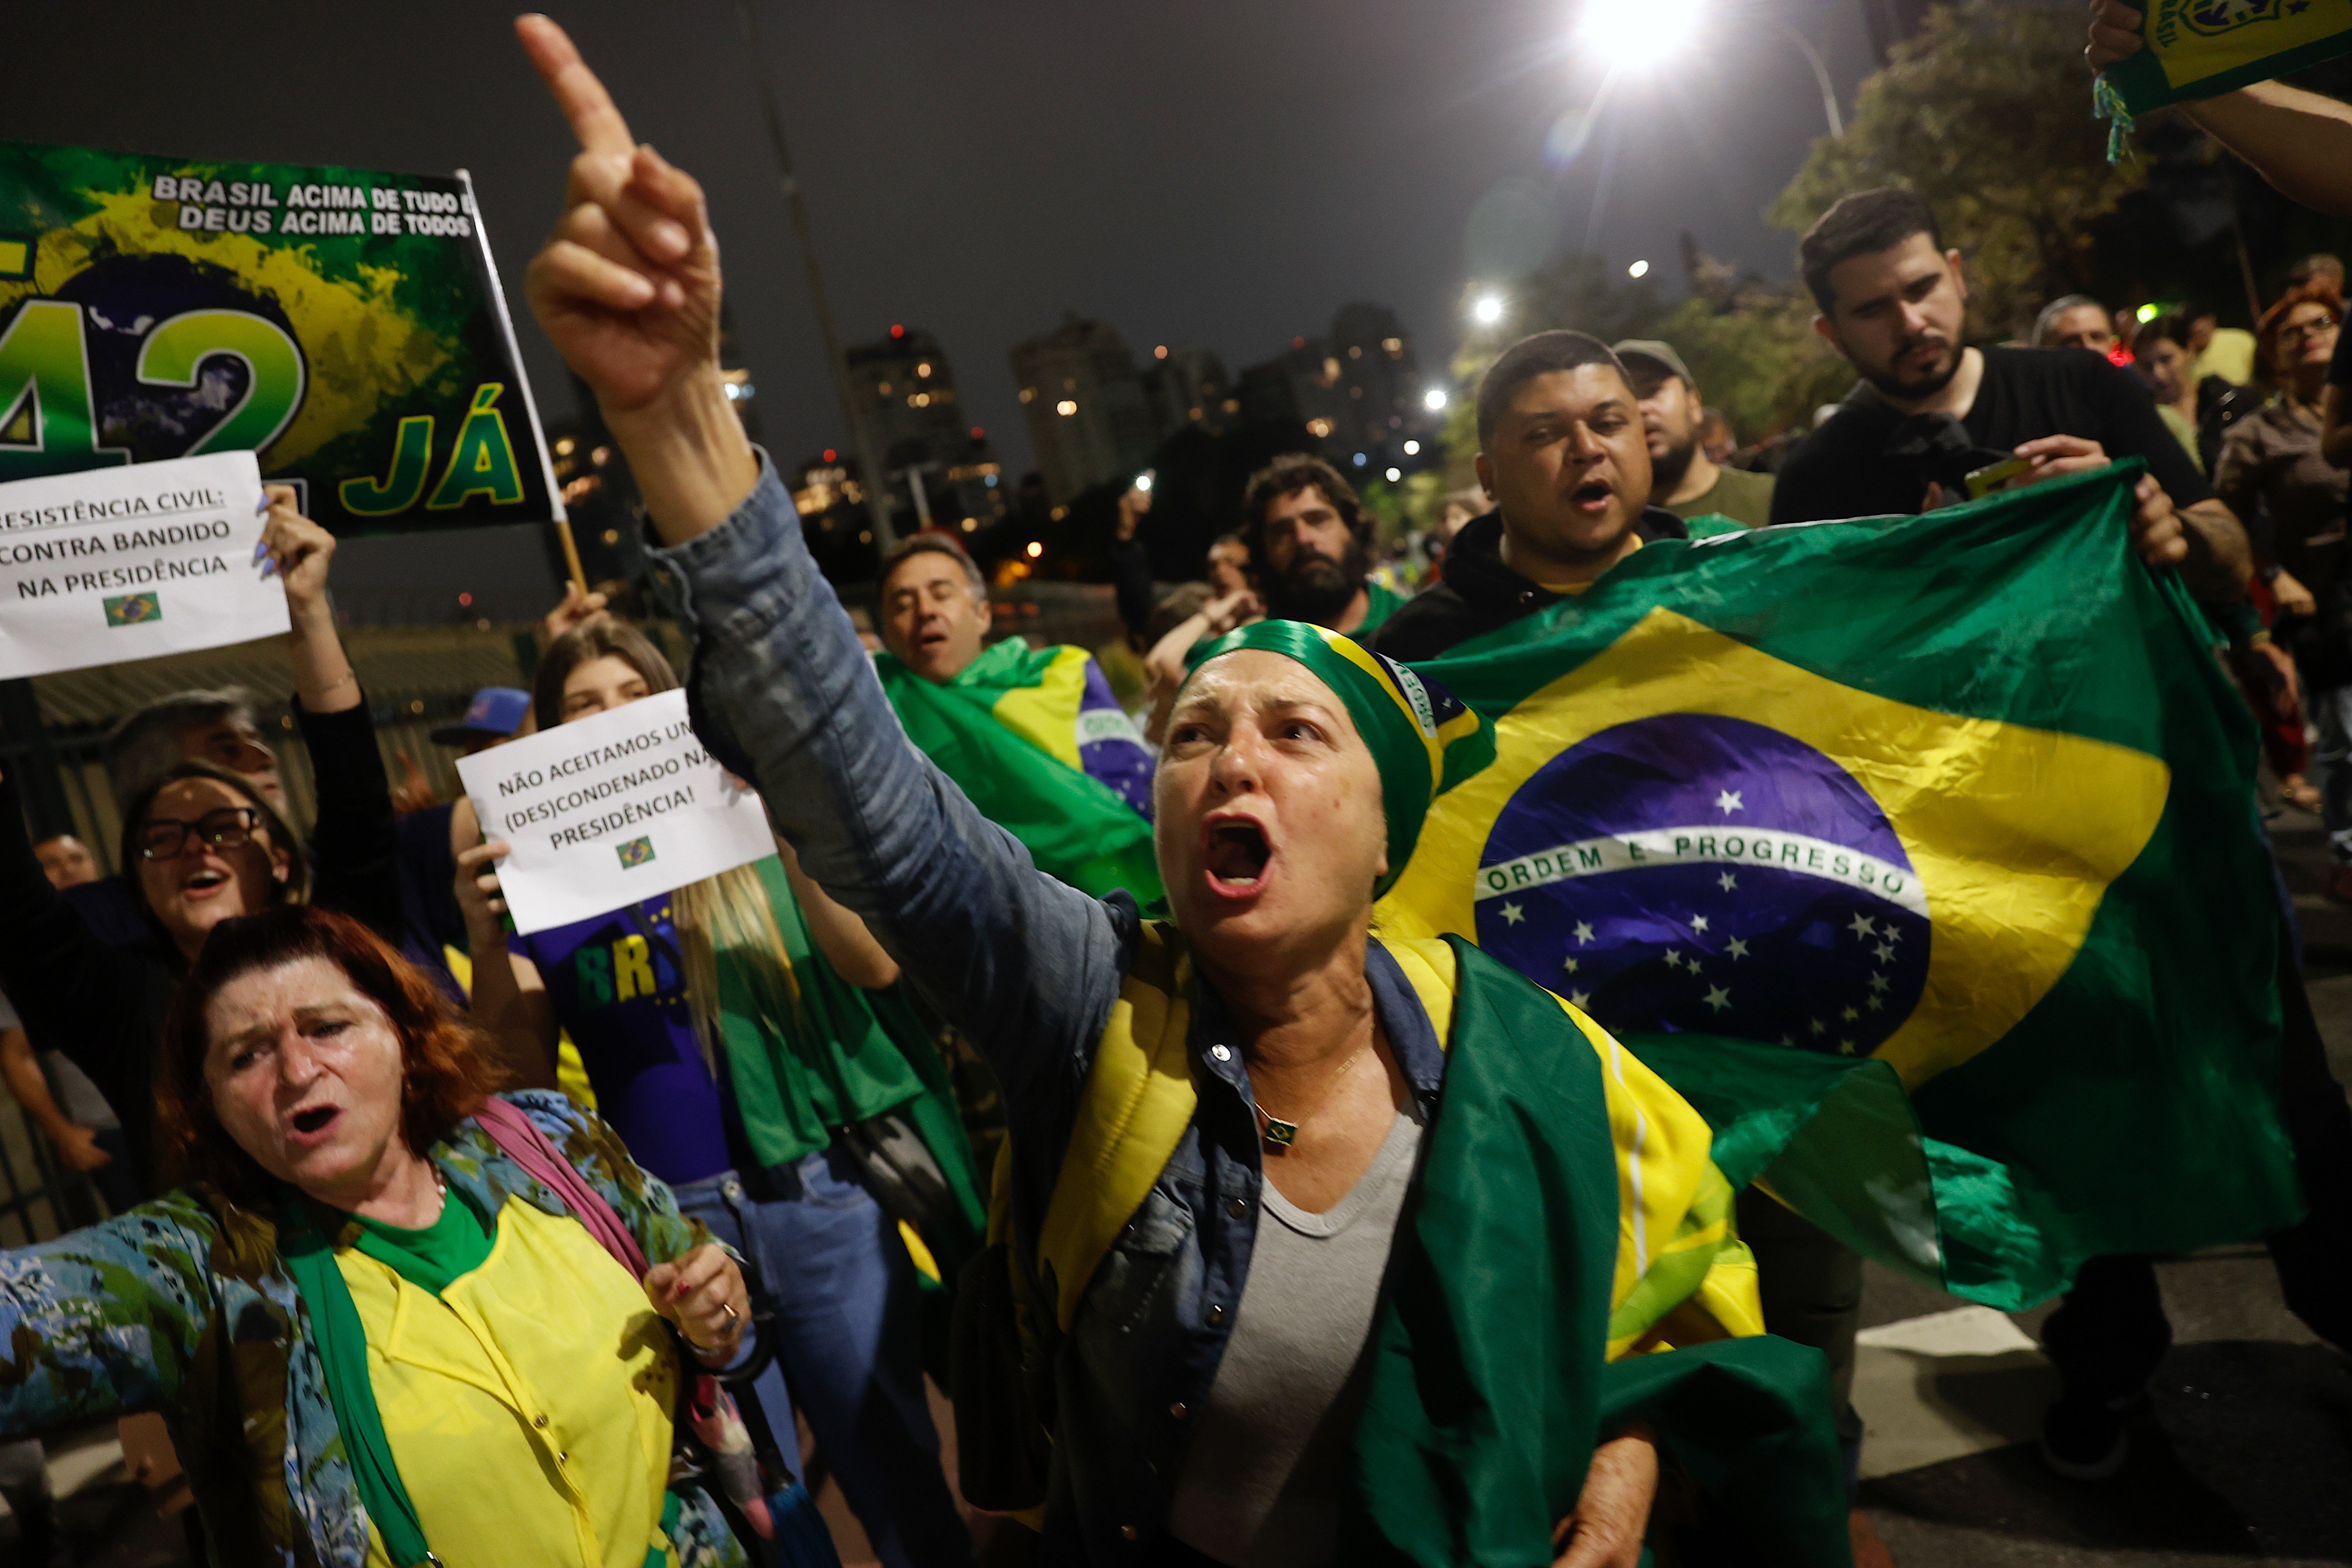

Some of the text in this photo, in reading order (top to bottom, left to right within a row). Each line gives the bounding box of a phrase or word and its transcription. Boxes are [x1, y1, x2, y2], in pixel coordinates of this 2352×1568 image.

[153, 175, 279, 207] BRASIL
[286, 184, 368, 209] ACIMA
[370, 187, 401, 211] DE
[401, 190, 459, 214] TUDO
[179, 205, 471, 238] DEUS ACIMA DE TODOS
[338, 382, 525, 517] JÁ
[0, 488, 223, 529] ESISTÊNCIA CIVIL:
[0, 519, 230, 566] CONTRA BANDIDO
[17, 555, 228, 598] NA PRESIDÊNCIA
[498, 770, 543, 797] NÃO
[550, 730, 661, 781] ACEITAMOS
[505, 758, 679, 833] (DES)CONDENADO
[550, 786, 695, 850] PRESIDÊNCIA!
[1488, 836, 1904, 894] ORDEM E PROGRESSO
